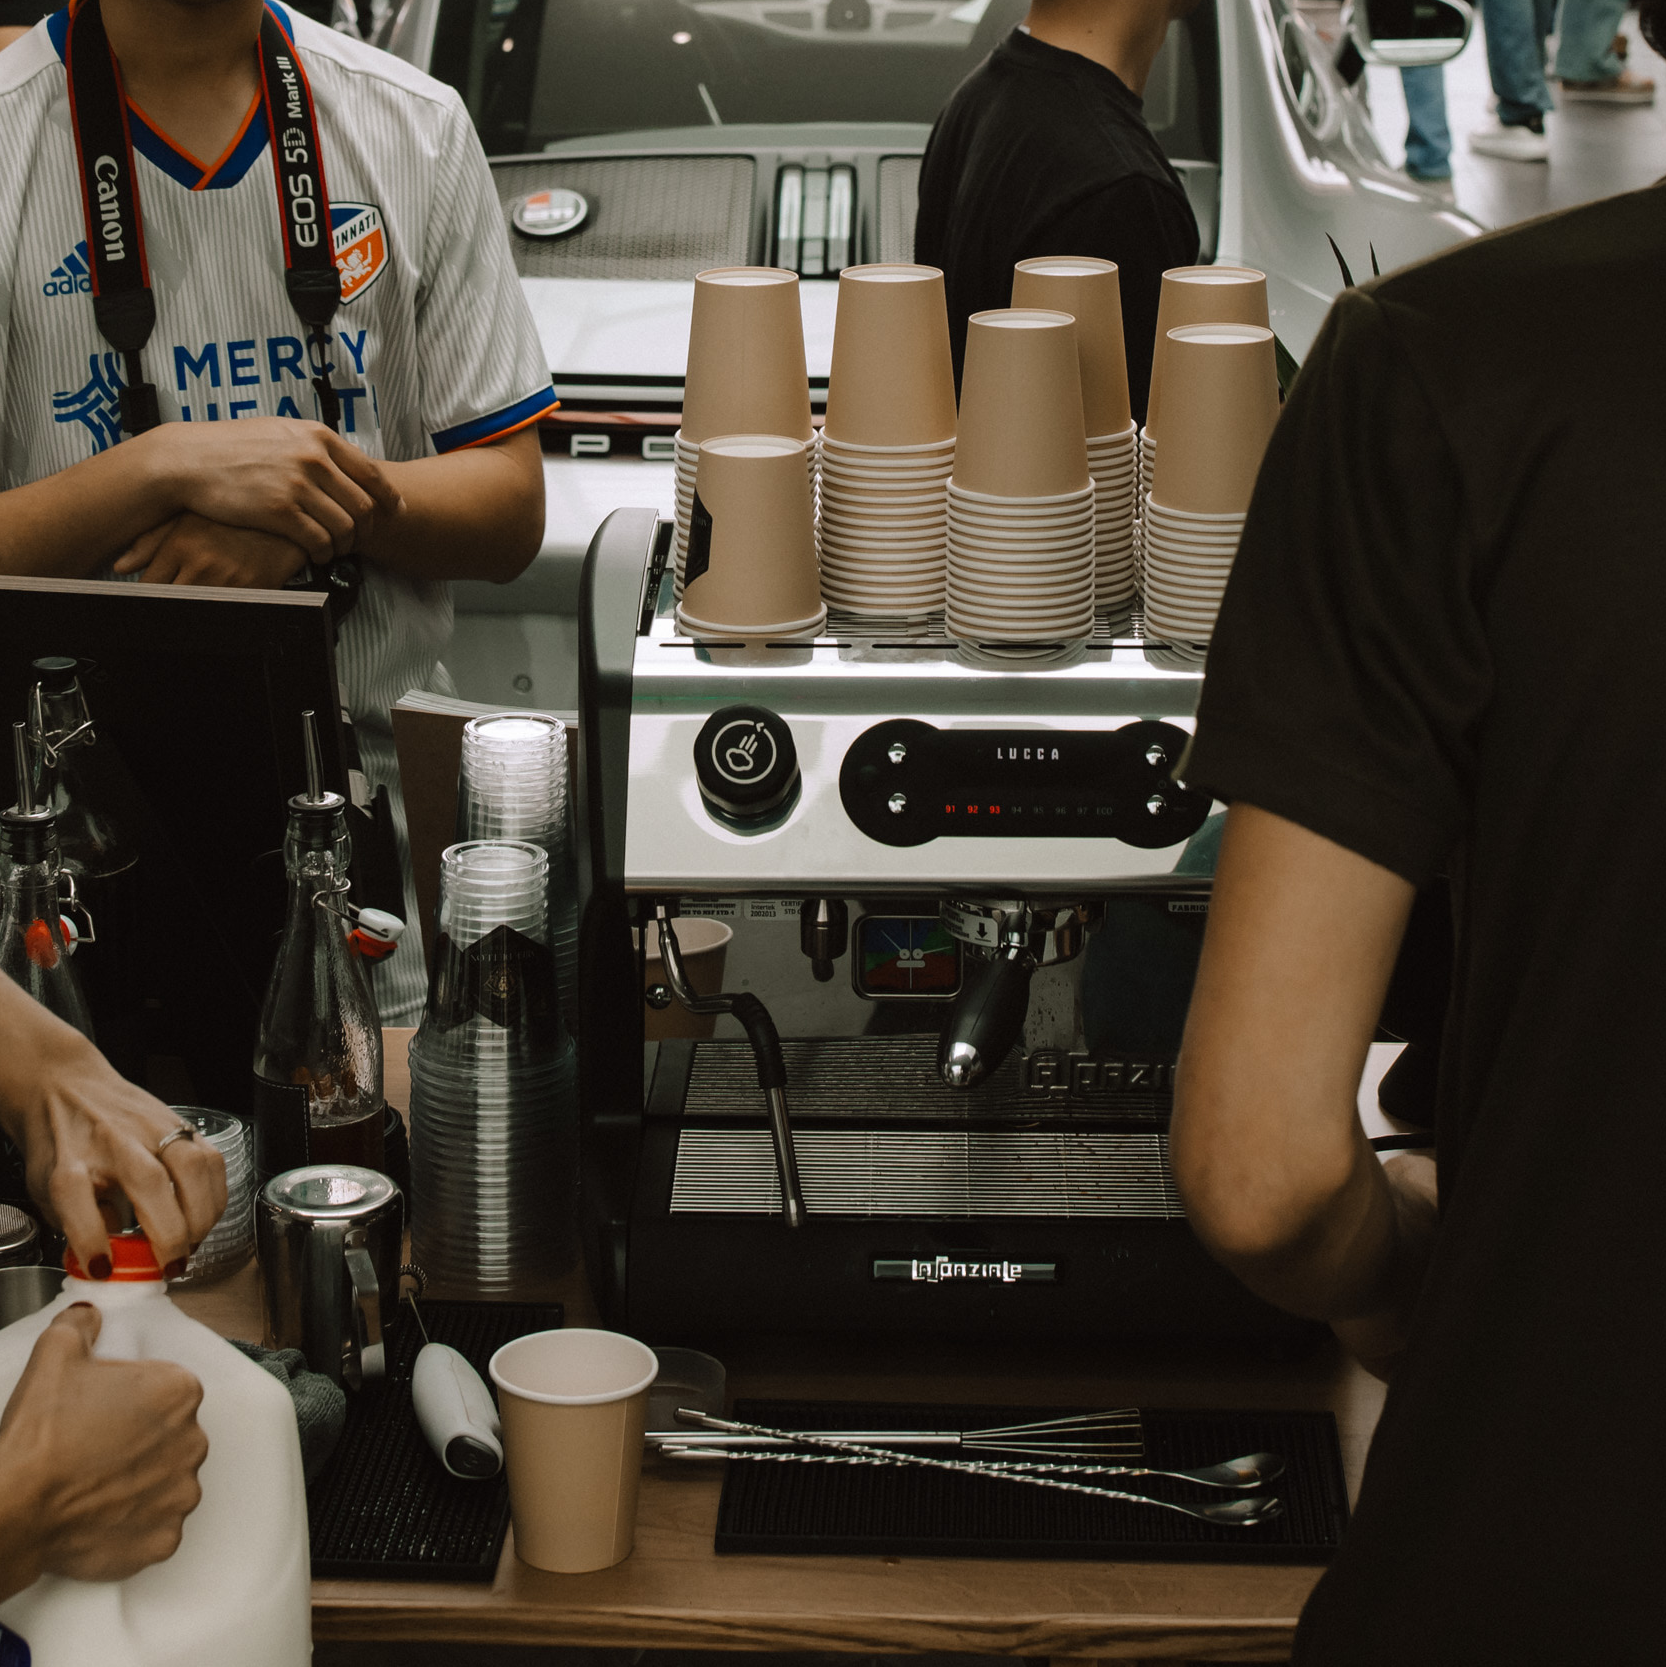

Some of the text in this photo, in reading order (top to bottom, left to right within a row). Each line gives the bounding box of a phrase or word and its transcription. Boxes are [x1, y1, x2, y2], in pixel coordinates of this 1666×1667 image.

[282, 72, 303, 119] Mark
[282, 127, 309, 164] 5D
[94, 155, 126, 262] Canon
[288, 173, 319, 248] EOS
[173, 330, 367, 391] MERCY
[997, 747, 1060, 760] LUCCA
[945, 804, 956, 814] 91
[967, 805, 979, 814] 92
[989, 805, 1001, 815] 93
[1011, 806, 1022, 815] 94
